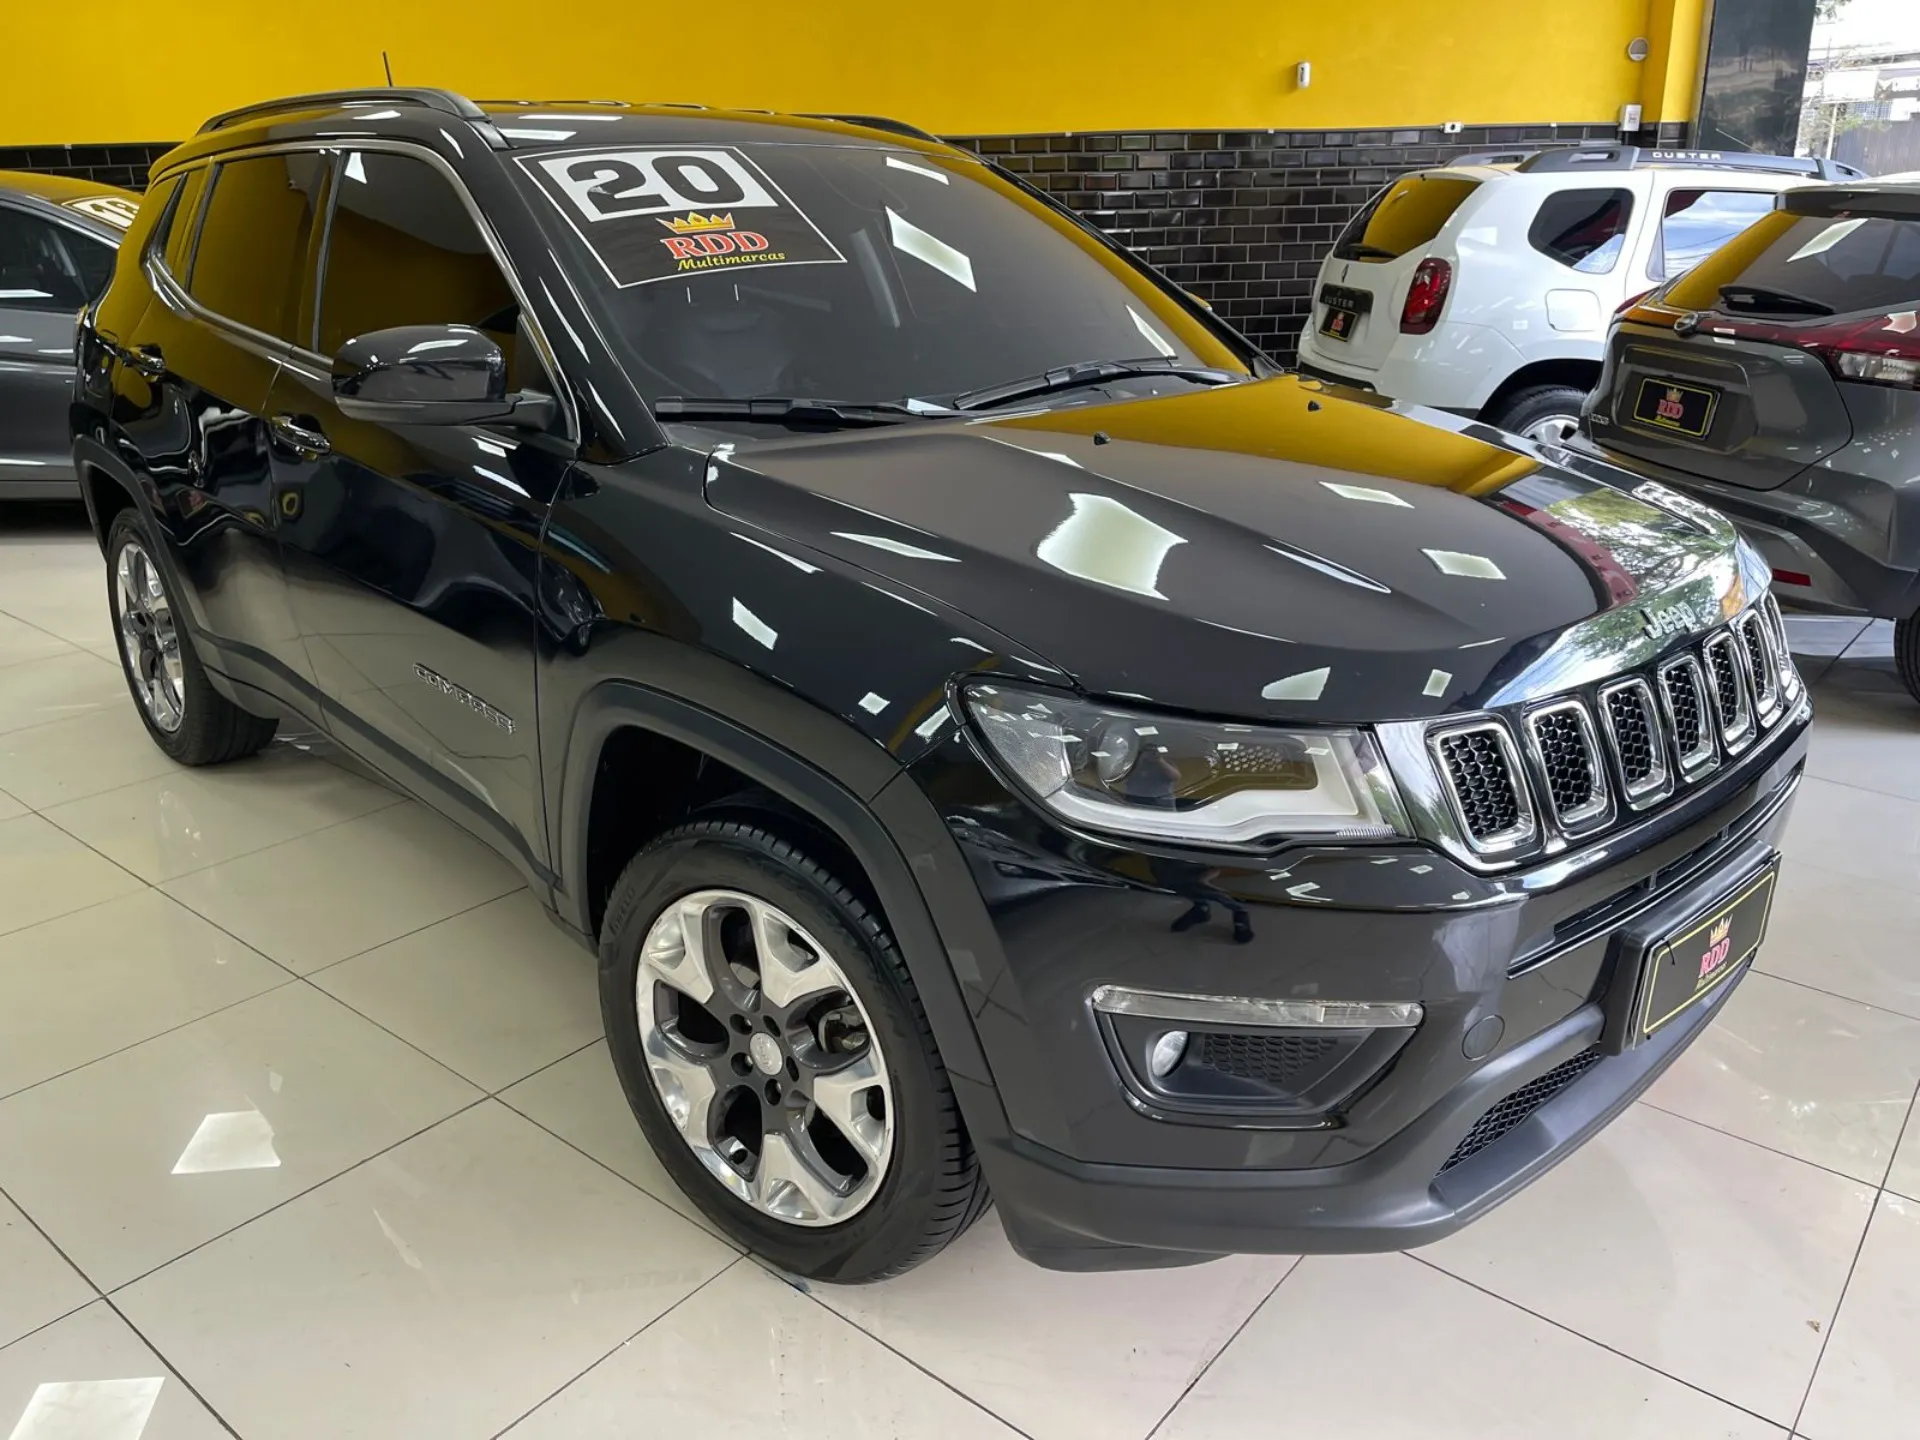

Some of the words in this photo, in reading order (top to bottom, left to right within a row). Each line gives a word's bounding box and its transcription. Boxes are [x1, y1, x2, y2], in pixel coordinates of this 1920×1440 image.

[1652, 151, 1721, 160] DUSTER
[566, 155, 745, 215] 20
[660, 231, 769, 259] RDD
[677, 252, 786, 271] Multimarcas
[1642, 601, 1696, 640] Jeep
[1698, 937, 1730, 979] RDD
